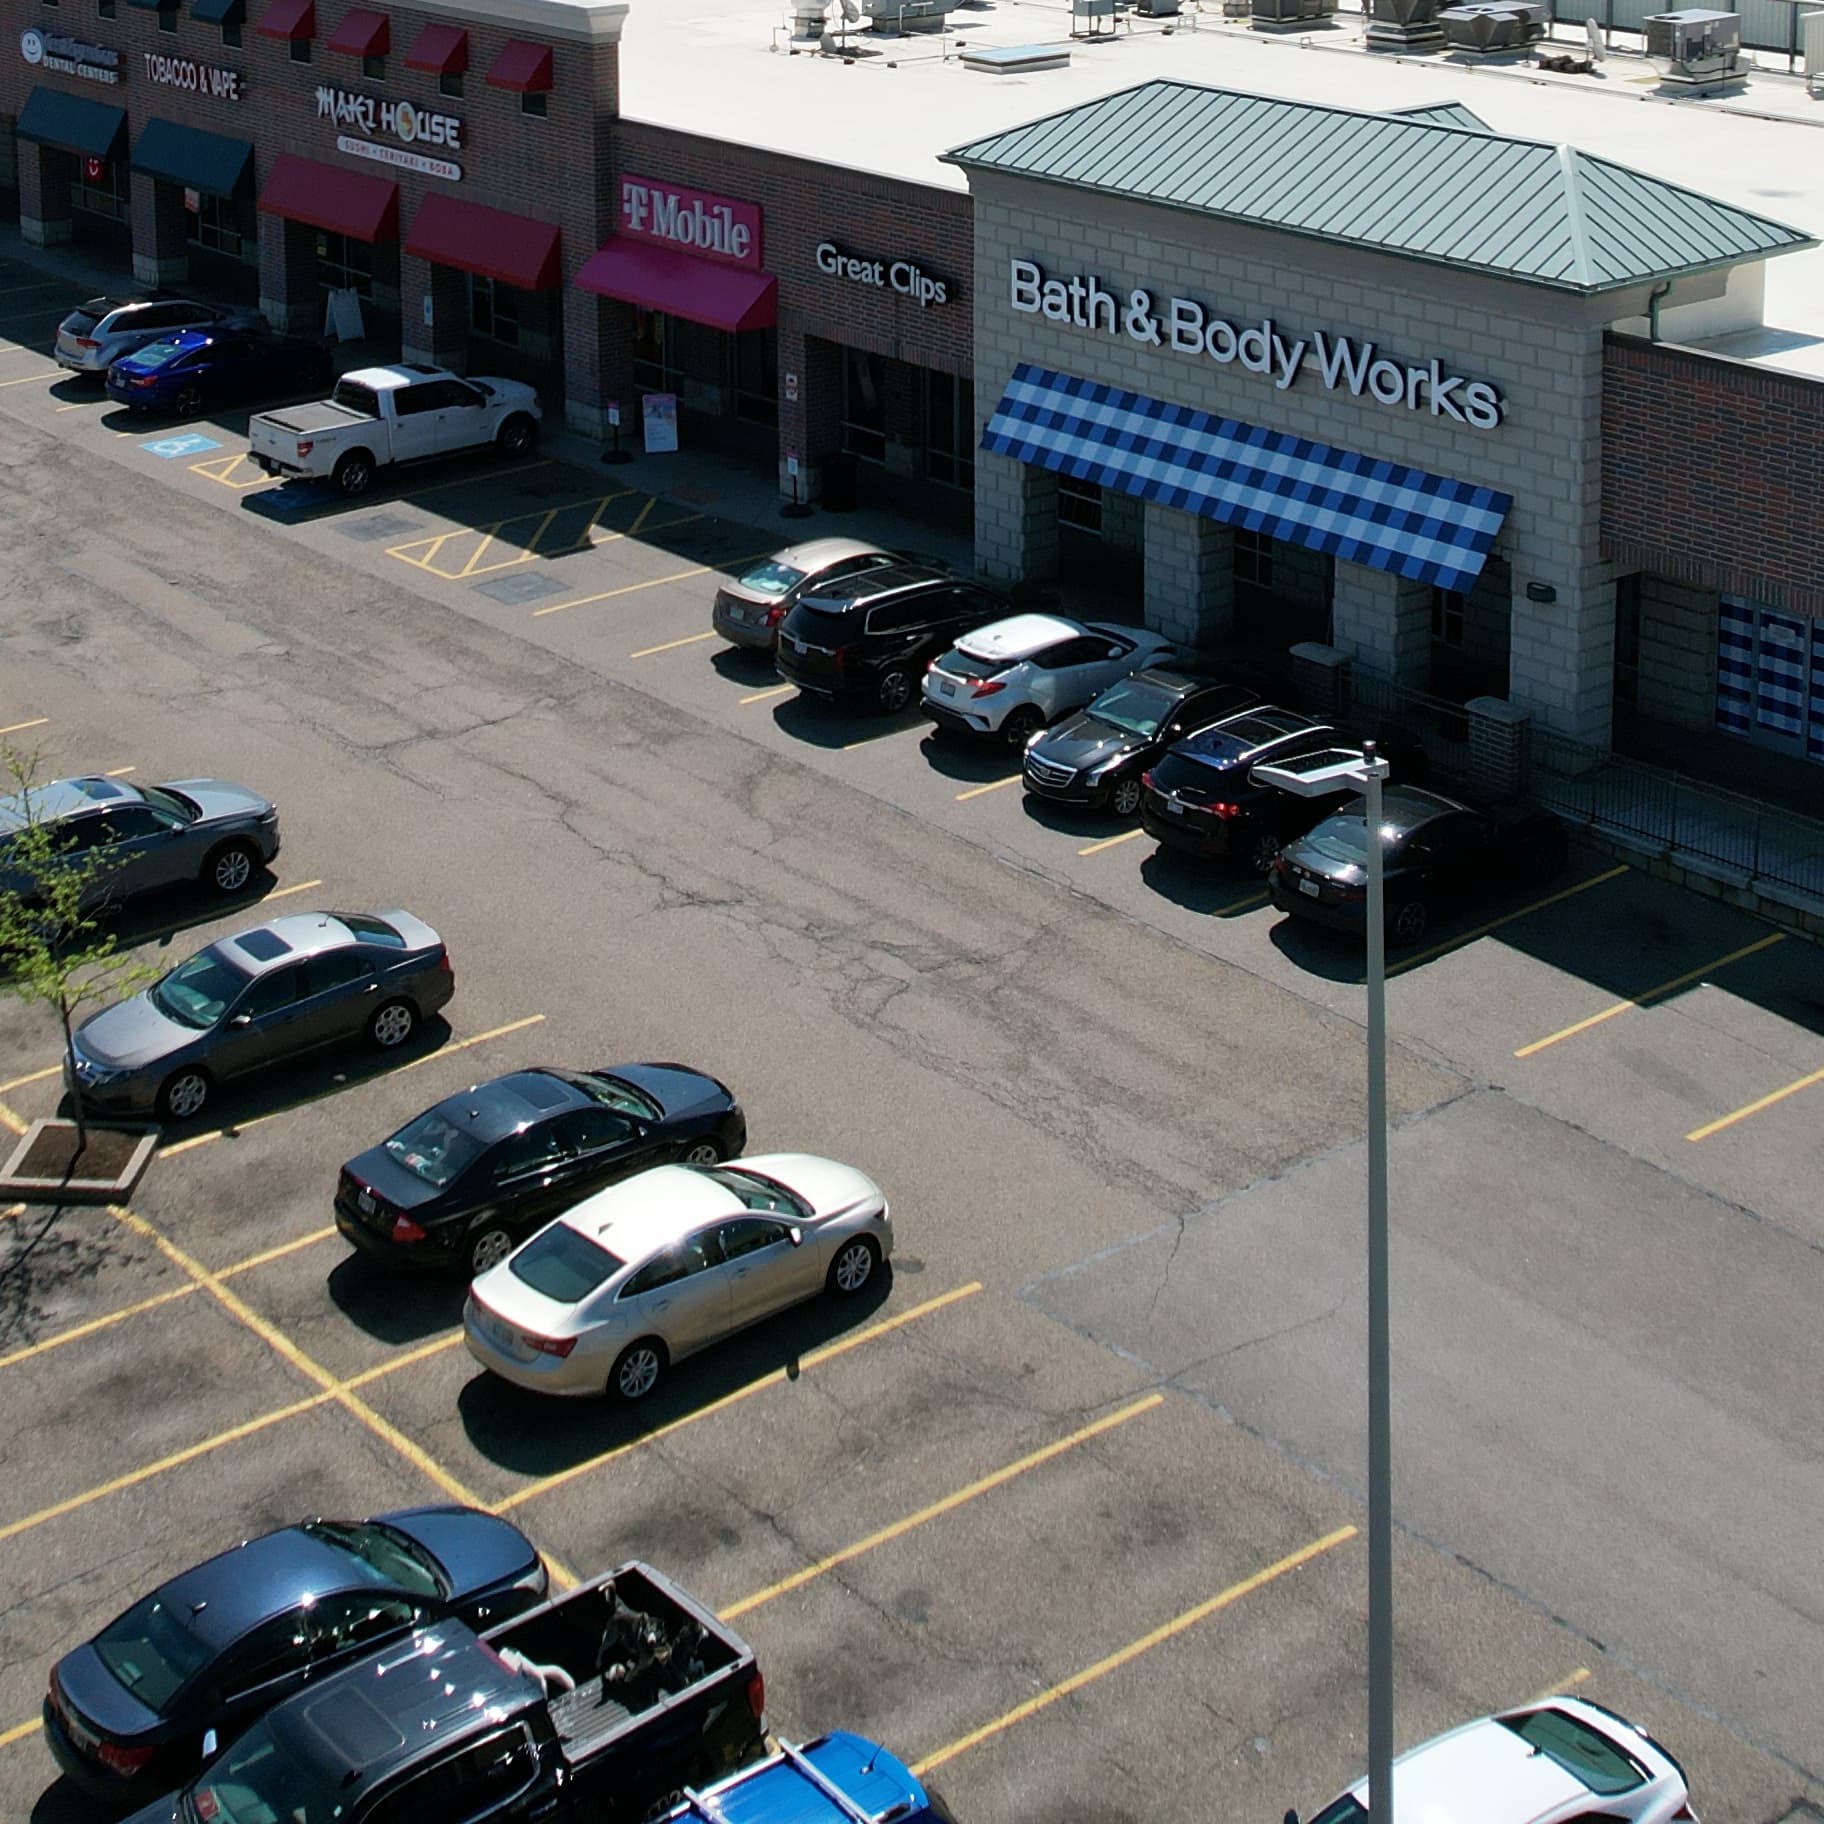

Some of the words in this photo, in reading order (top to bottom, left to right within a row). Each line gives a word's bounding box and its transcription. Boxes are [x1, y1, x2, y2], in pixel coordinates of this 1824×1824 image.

[144, 52, 197, 91] TOBACCO
[199, 64, 208, 94] &
[209, 67, 239, 101] VAPE
[314, 85, 377, 136] MAKI
[380, 101, 461, 150] HOUSE
[816, 242, 885, 287] Great
[889, 261, 947, 307] Clips
[1010, 259, 1117, 334] Bath
[1125, 288, 1163, 347] &
[1170, 297, 1308, 390] Body
[1313, 330, 1506, 431] Works
